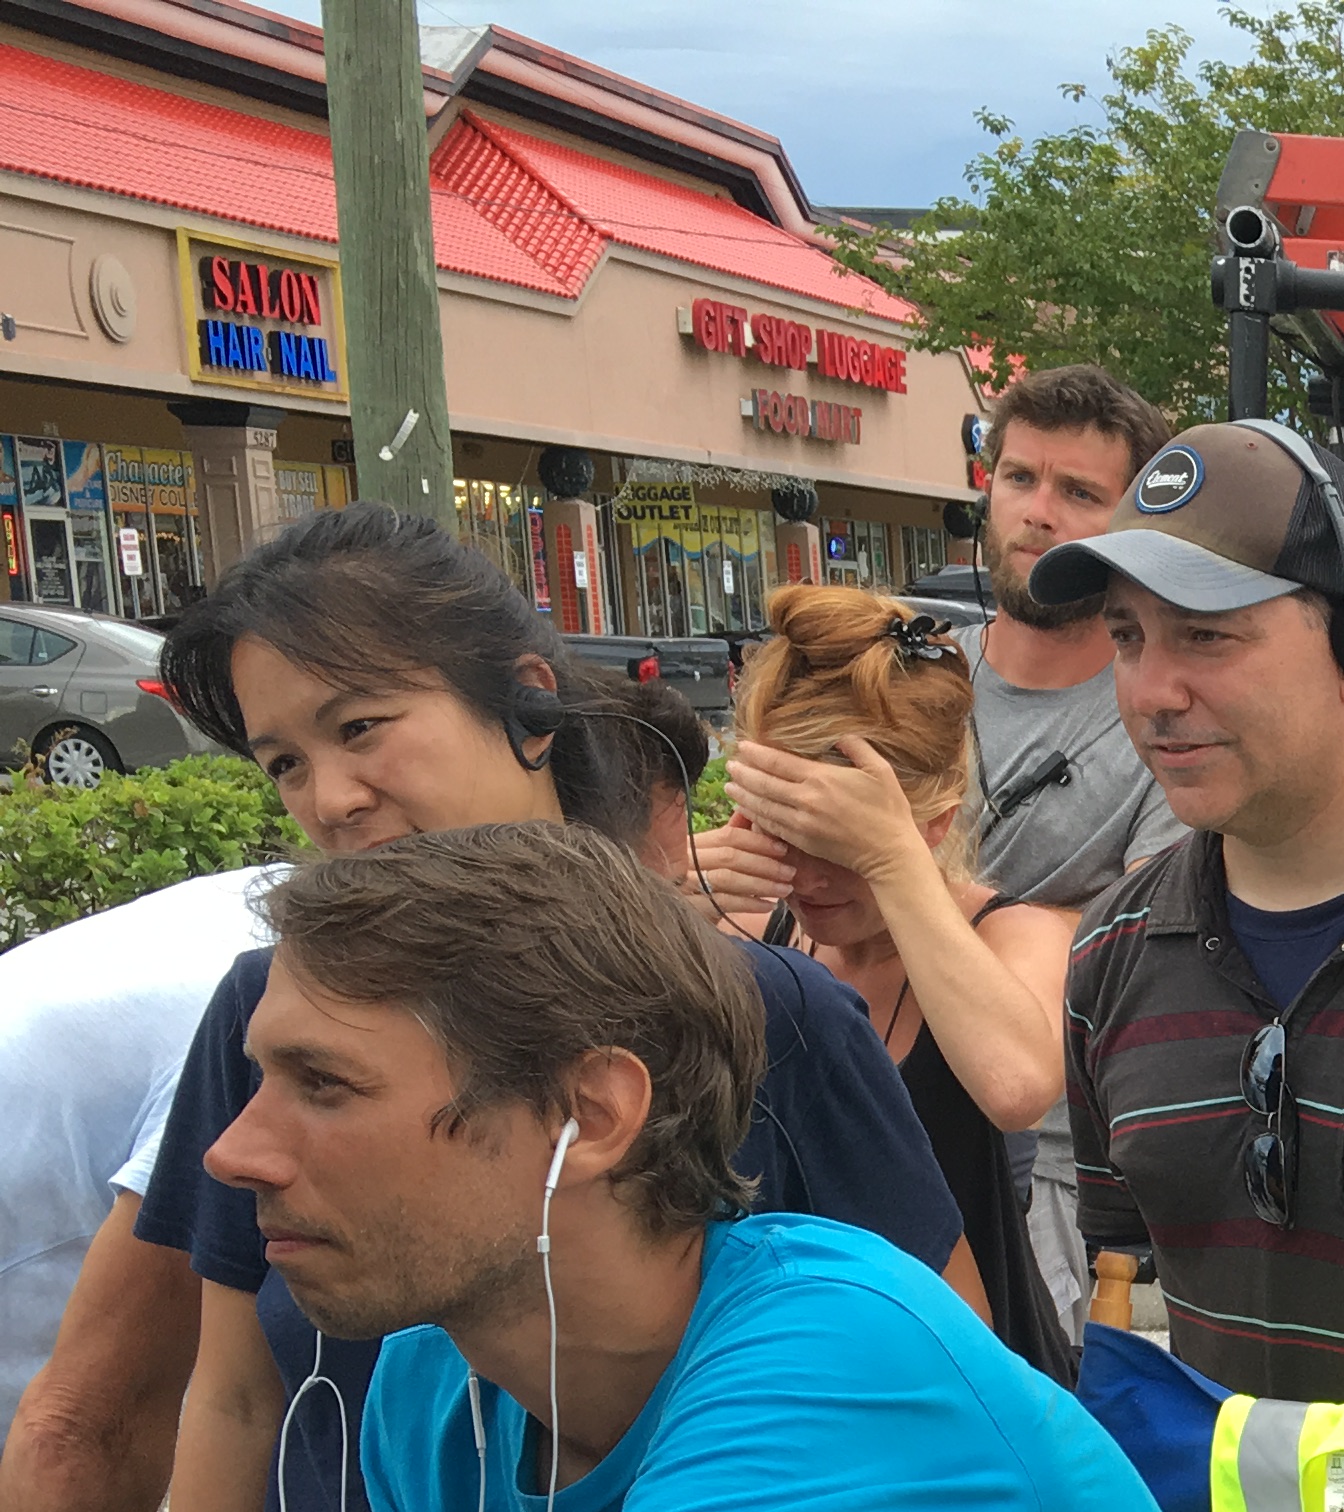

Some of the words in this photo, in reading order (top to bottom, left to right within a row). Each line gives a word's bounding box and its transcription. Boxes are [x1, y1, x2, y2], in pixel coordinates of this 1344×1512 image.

[211, 255, 322, 326] SALON
[207, 319, 268, 372] HAIR
[278, 331, 338, 382] NAIL
[694, 298, 748, 357] GIFT
[752, 313, 813, 371] SHOP
[817, 329, 908, 394] LUGGAGE
[755, 389, 811, 437] FOOD
[815, 400, 863, 445] MART
[105, 451, 192, 487] Chaacter
[278, 470, 297, 491] BUY
[299, 472, 319, 493] SELL
[616, 504, 693, 520] OUTLET
